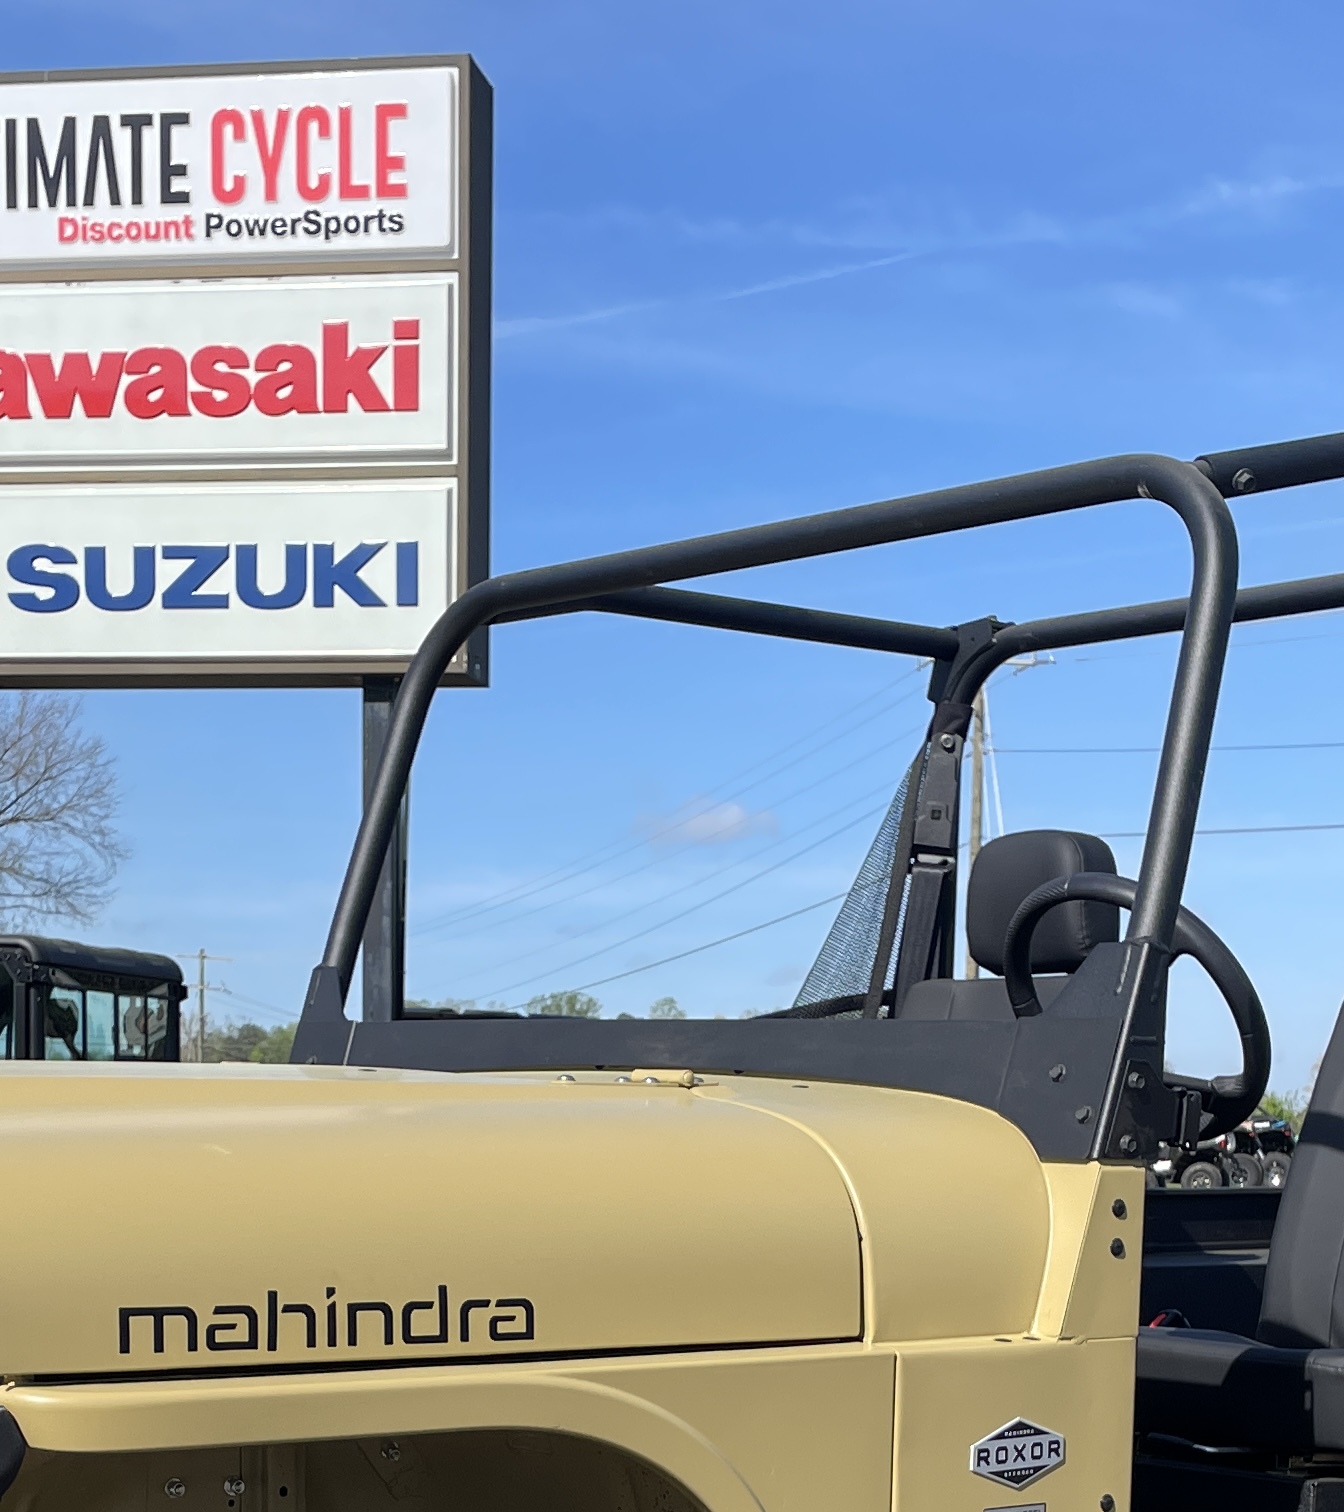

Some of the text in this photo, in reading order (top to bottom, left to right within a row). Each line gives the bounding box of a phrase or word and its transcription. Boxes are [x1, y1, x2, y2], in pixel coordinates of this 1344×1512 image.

[209, 100, 409, 206] CYCLE
[57, 207, 405, 245] Discount PowerSports
[5, 540, 420, 613] SUZUKI
[118, 1283, 535, 1354] mahindra
[976, 1439, 1061, 1468] ROXOR
